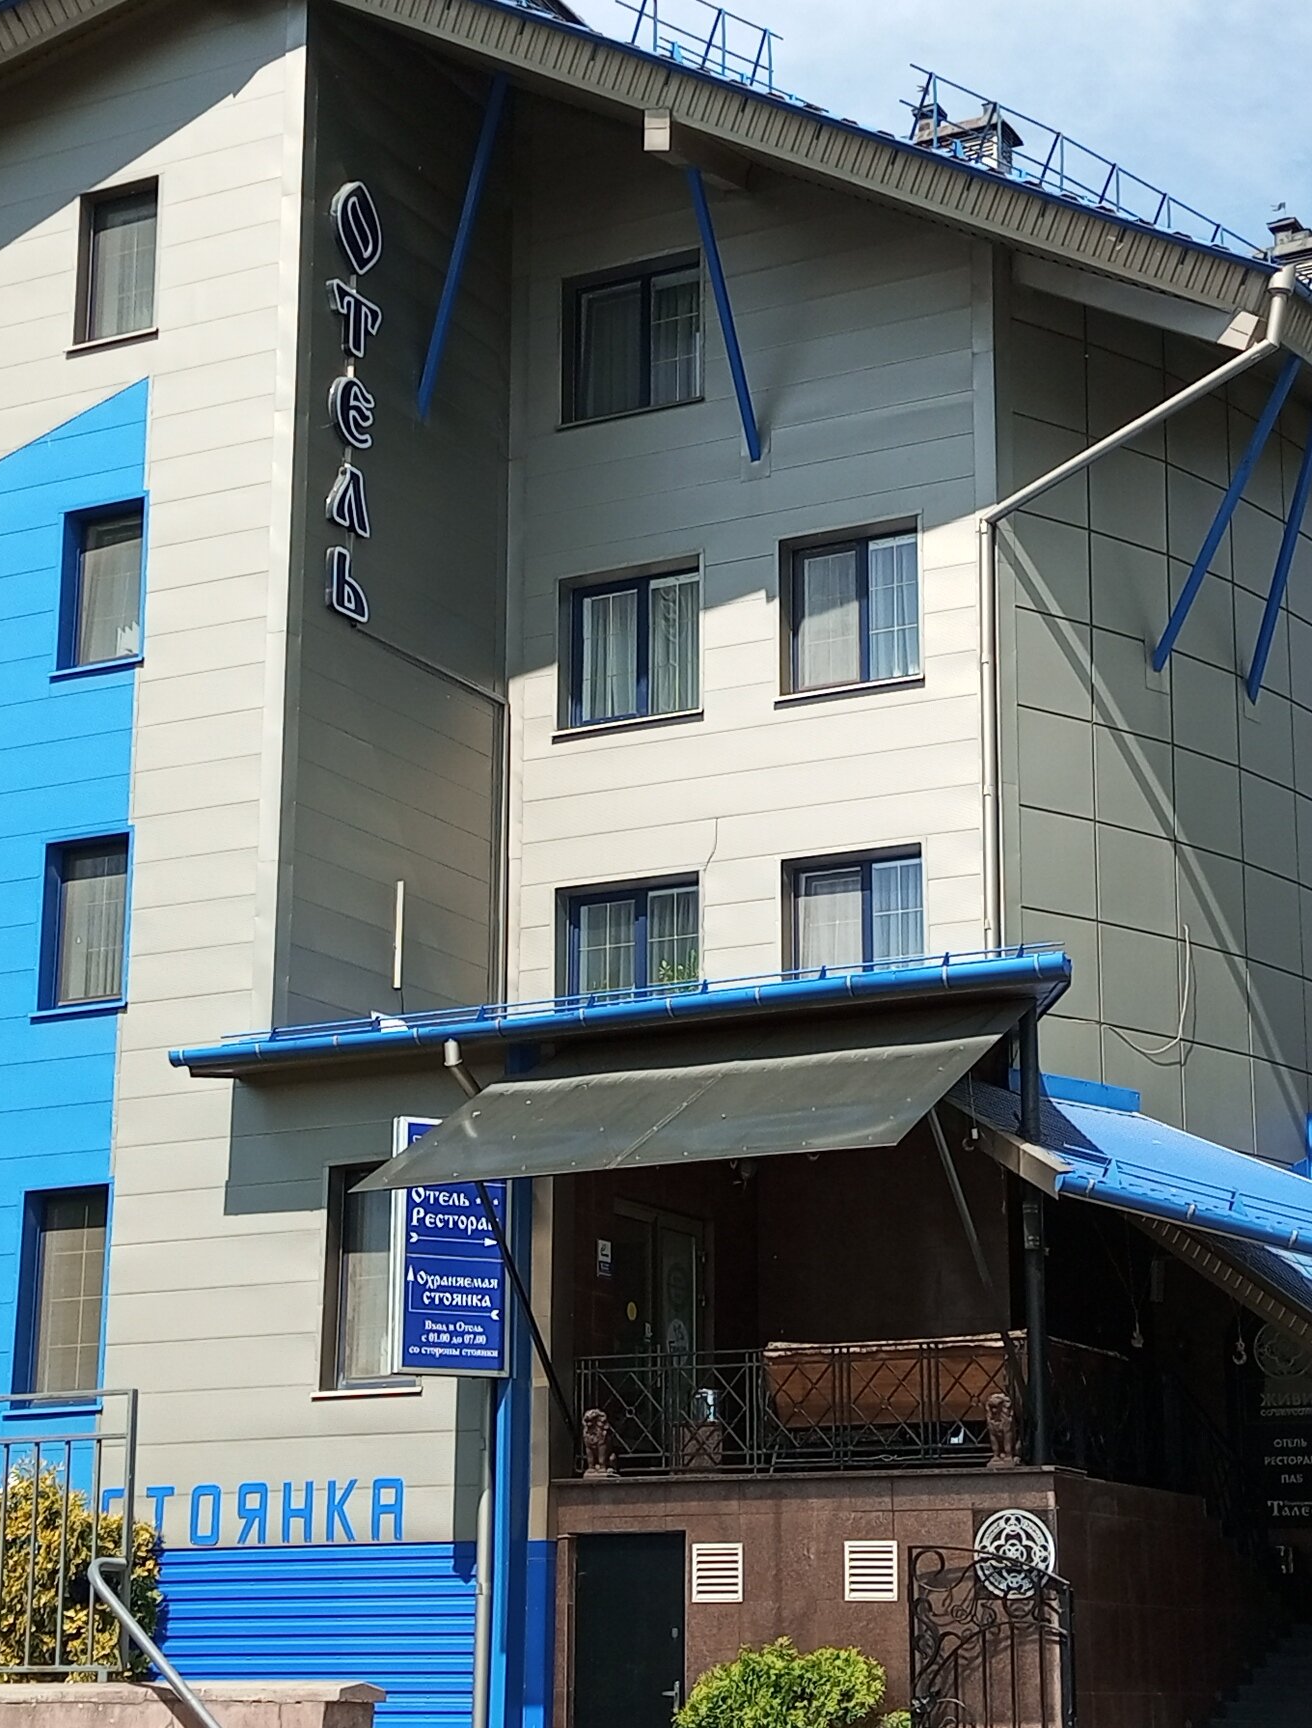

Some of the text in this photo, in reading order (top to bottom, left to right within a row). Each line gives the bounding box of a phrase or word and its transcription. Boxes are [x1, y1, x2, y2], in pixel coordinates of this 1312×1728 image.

[411, 1186, 470, 1207] Отель
[416, 1270, 499, 1291] Охраняемая
[424, 1319, 448, 1332] Вход
[456, 1321, 484, 1333] Отель
[428, 1332, 450, 1343] 01.00
[451, 1336, 463, 1344] до
[463, 1334, 487, 1345] 07.00
[408, 1345, 499, 1358] со стороны стоянки
[1273, 1438, 1308, 1448] ОТЕЛЬ
[1280, 1473, 1304, 1484] ПАБ
